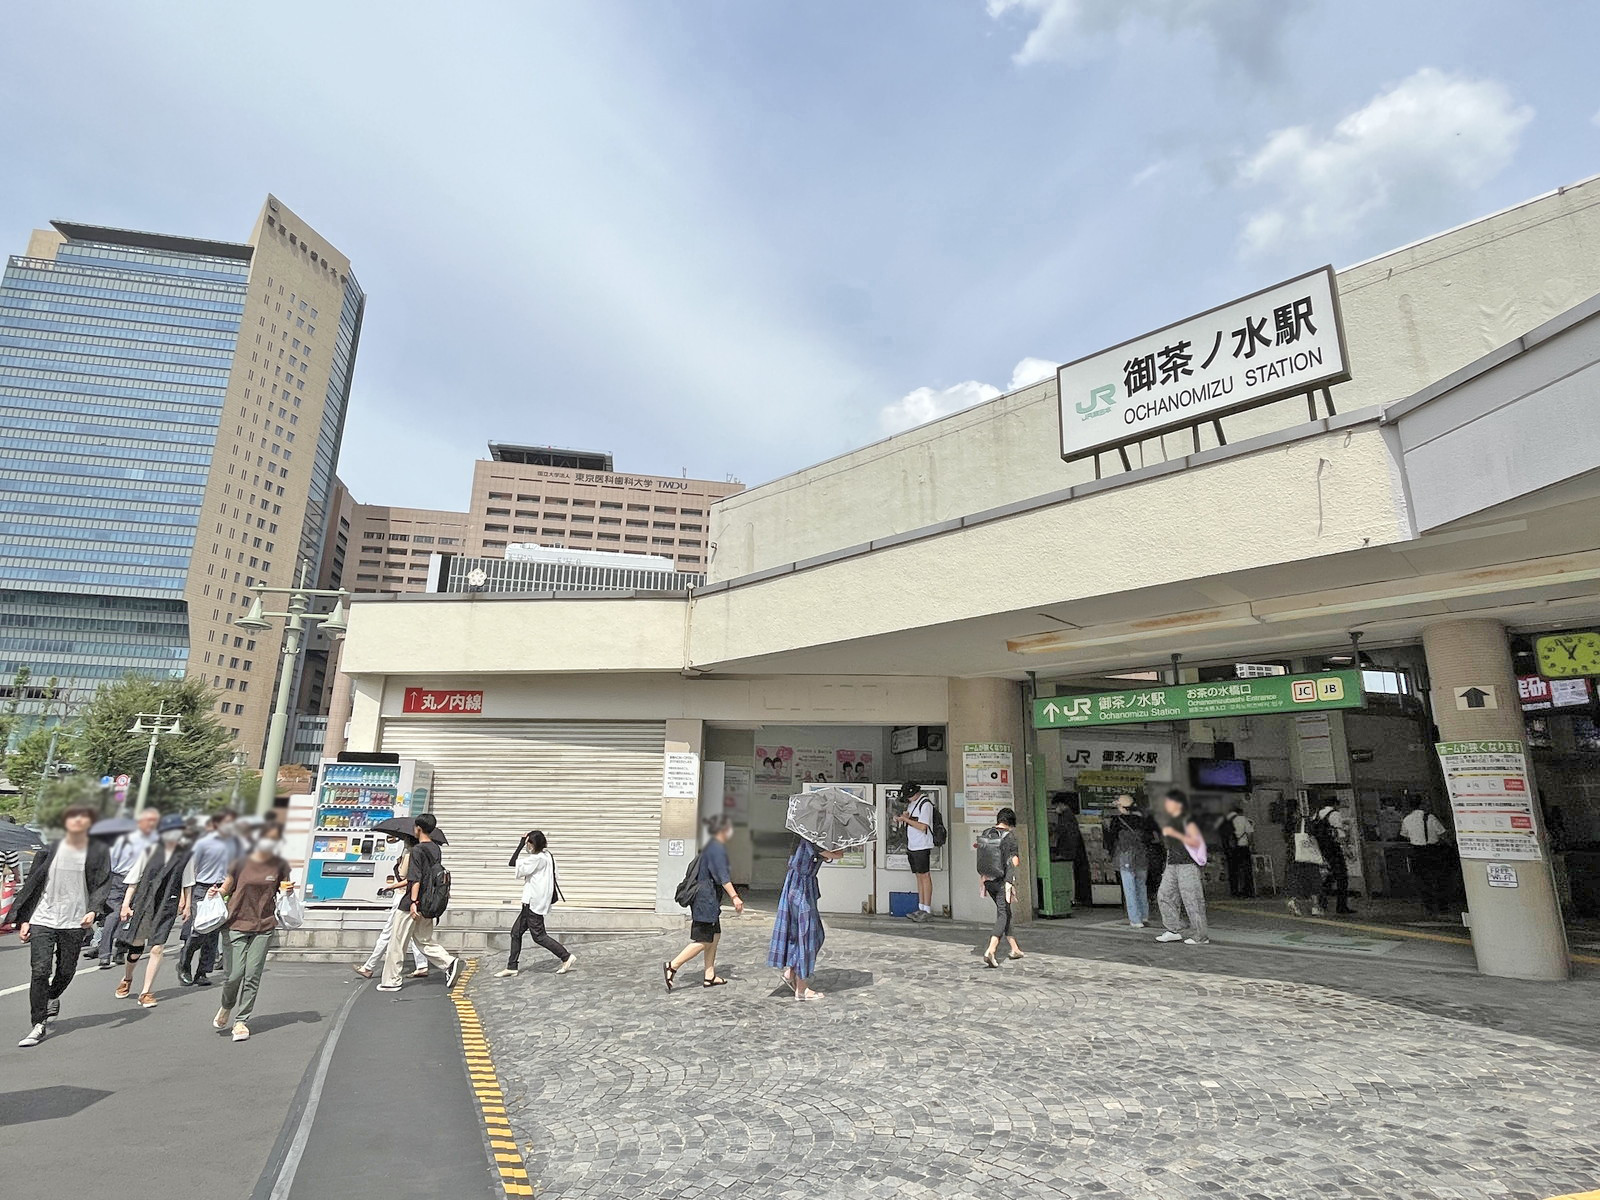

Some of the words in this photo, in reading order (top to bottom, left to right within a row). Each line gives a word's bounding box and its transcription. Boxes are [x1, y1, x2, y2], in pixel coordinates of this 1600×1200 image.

[1123, 296, 1318, 398] 御茶ノ水駅
[1124, 376, 1234, 425] OCHANOMIZU
[1245, 347, 1323, 387] STATION
[1075, 383, 1117, 414] JR
[575, 472, 653, 488] 東京医科歯科大学
[657, 480, 688, 490] TMDU
[1186, 684, 1251, 699] お茶の水橋口
[1298, 688, 1311, 696] JC
[1324, 684, 1337, 694] JB
[421, 693, 482, 711] 丸ノ内線
[1098, 691, 1166, 710] 御茶ノ水駅
[1246, 693, 1277, 702] Entrance
[1063, 698, 1092, 716] JR
[1099, 710, 1149, 720] Ochanomizu
[1151, 706, 1181, 717] Station
[1066, 749, 1091, 764] JR
[1102, 750, 1158, 763] 御茶ノ水駅
[886, 790, 899, 798] JR
